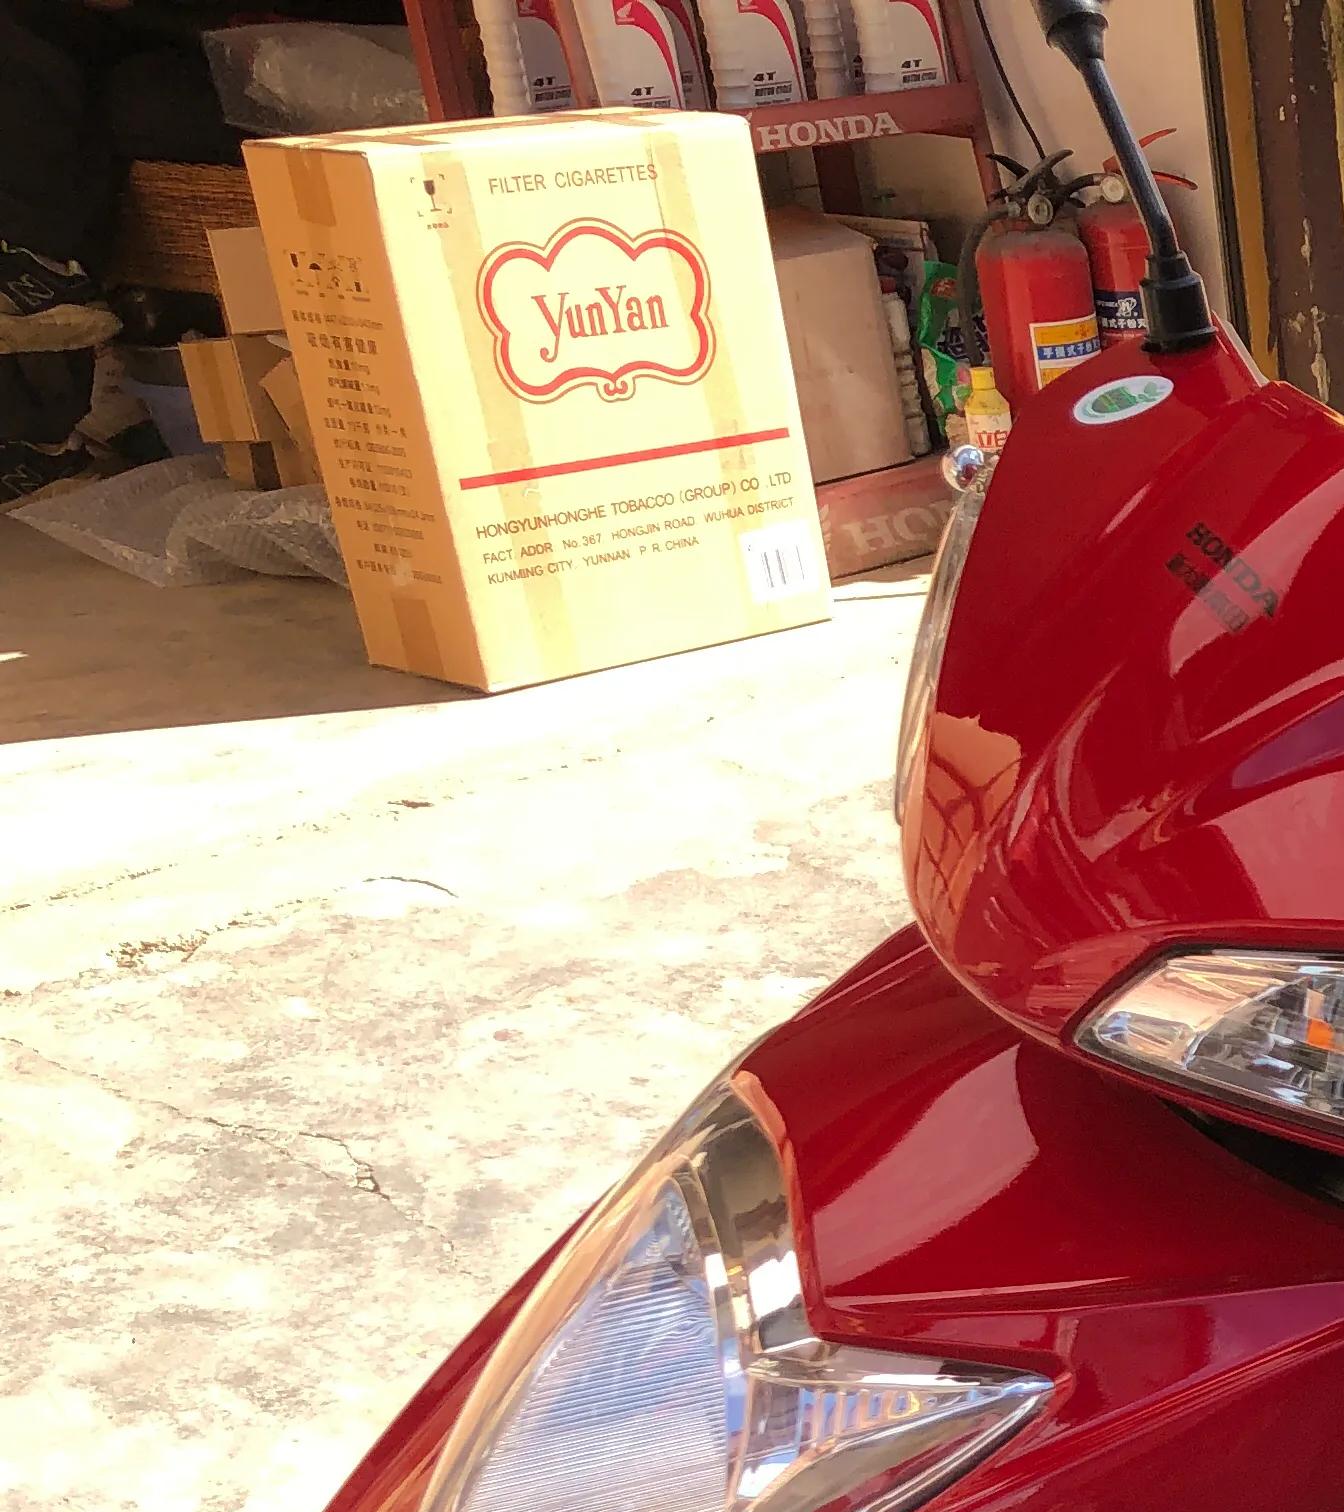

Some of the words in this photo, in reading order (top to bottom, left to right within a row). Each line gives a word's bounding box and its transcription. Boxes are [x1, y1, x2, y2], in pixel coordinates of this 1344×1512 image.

[756, 111, 903, 150] HONDA
[488, 174, 546, 194] FILTER
[554, 163, 658, 188] CIGARETTES
[531, 284, 670, 363] YunYan
[475, 505, 607, 539] HONGYUNHONGHE
[611, 493, 675, 516] TOBACCO
[679, 480, 736, 504] (GROUP)
[664, 516, 695, 530] ROAD
[747, 497, 794, 515] DISTRICT
[487, 565, 544, 584] KUNMING
[1185, 521, 1278, 618] HONDA
